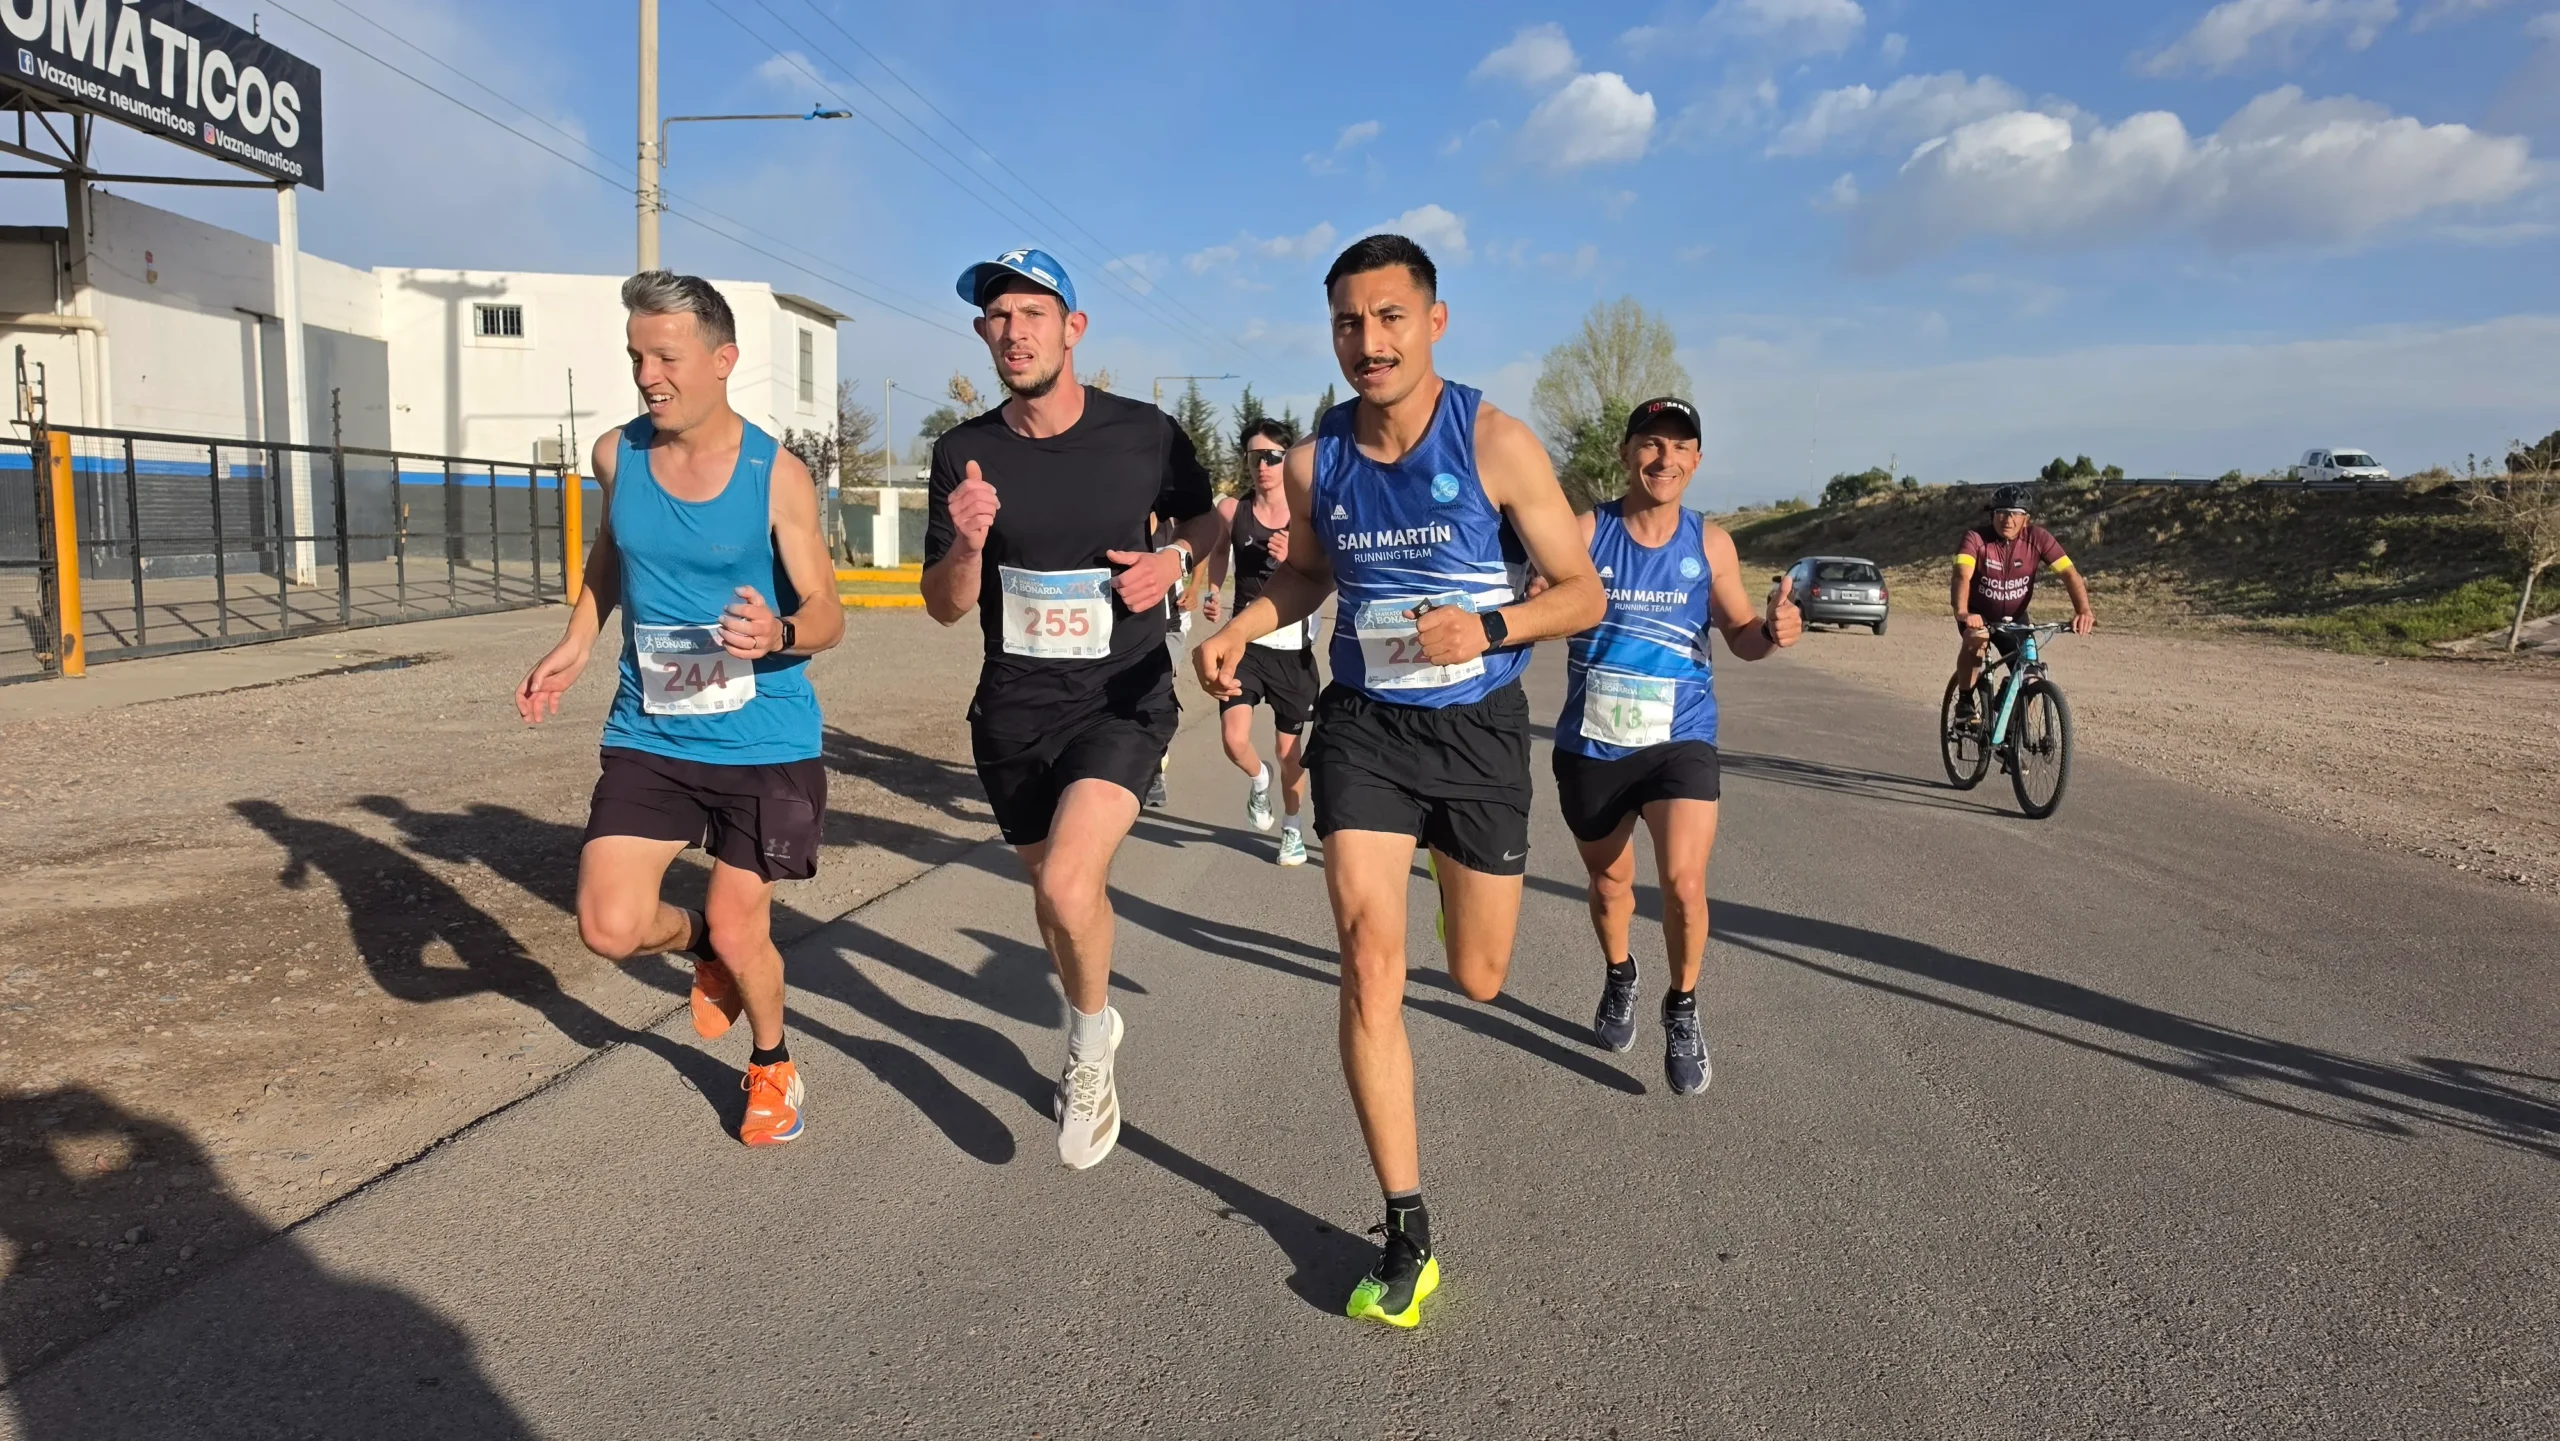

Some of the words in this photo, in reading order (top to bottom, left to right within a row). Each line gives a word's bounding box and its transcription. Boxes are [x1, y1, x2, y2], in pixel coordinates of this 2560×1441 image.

[37, 57, 106, 103] Vazquez
[110, 90, 196, 136] neumaticos
[214, 128, 303, 177] Vazneumaticos
[1338, 531, 1372, 550] SAN
[1377, 521, 1451, 548] MARTÍN
[1354, 550, 1401, 563] RUNNING
[1403, 548, 1432, 560] TEAM
[1020, 585, 1063, 595] BONARDA
[1981, 576, 2030, 590] CICLISMO
[1604, 588, 1632, 601] SAN
[1633, 588, 1688, 605] MARTÍN
[1979, 586, 2028, 600] BONARDA
[1614, 602, 1650, 612] RUNNING
[1651, 604, 1673, 613] TEAM
[1024, 606, 1090, 637] 255
[655, 640, 699, 649] BONARDA
[664, 661, 729, 692] 244
[1611, 705, 1642, 729] 13
